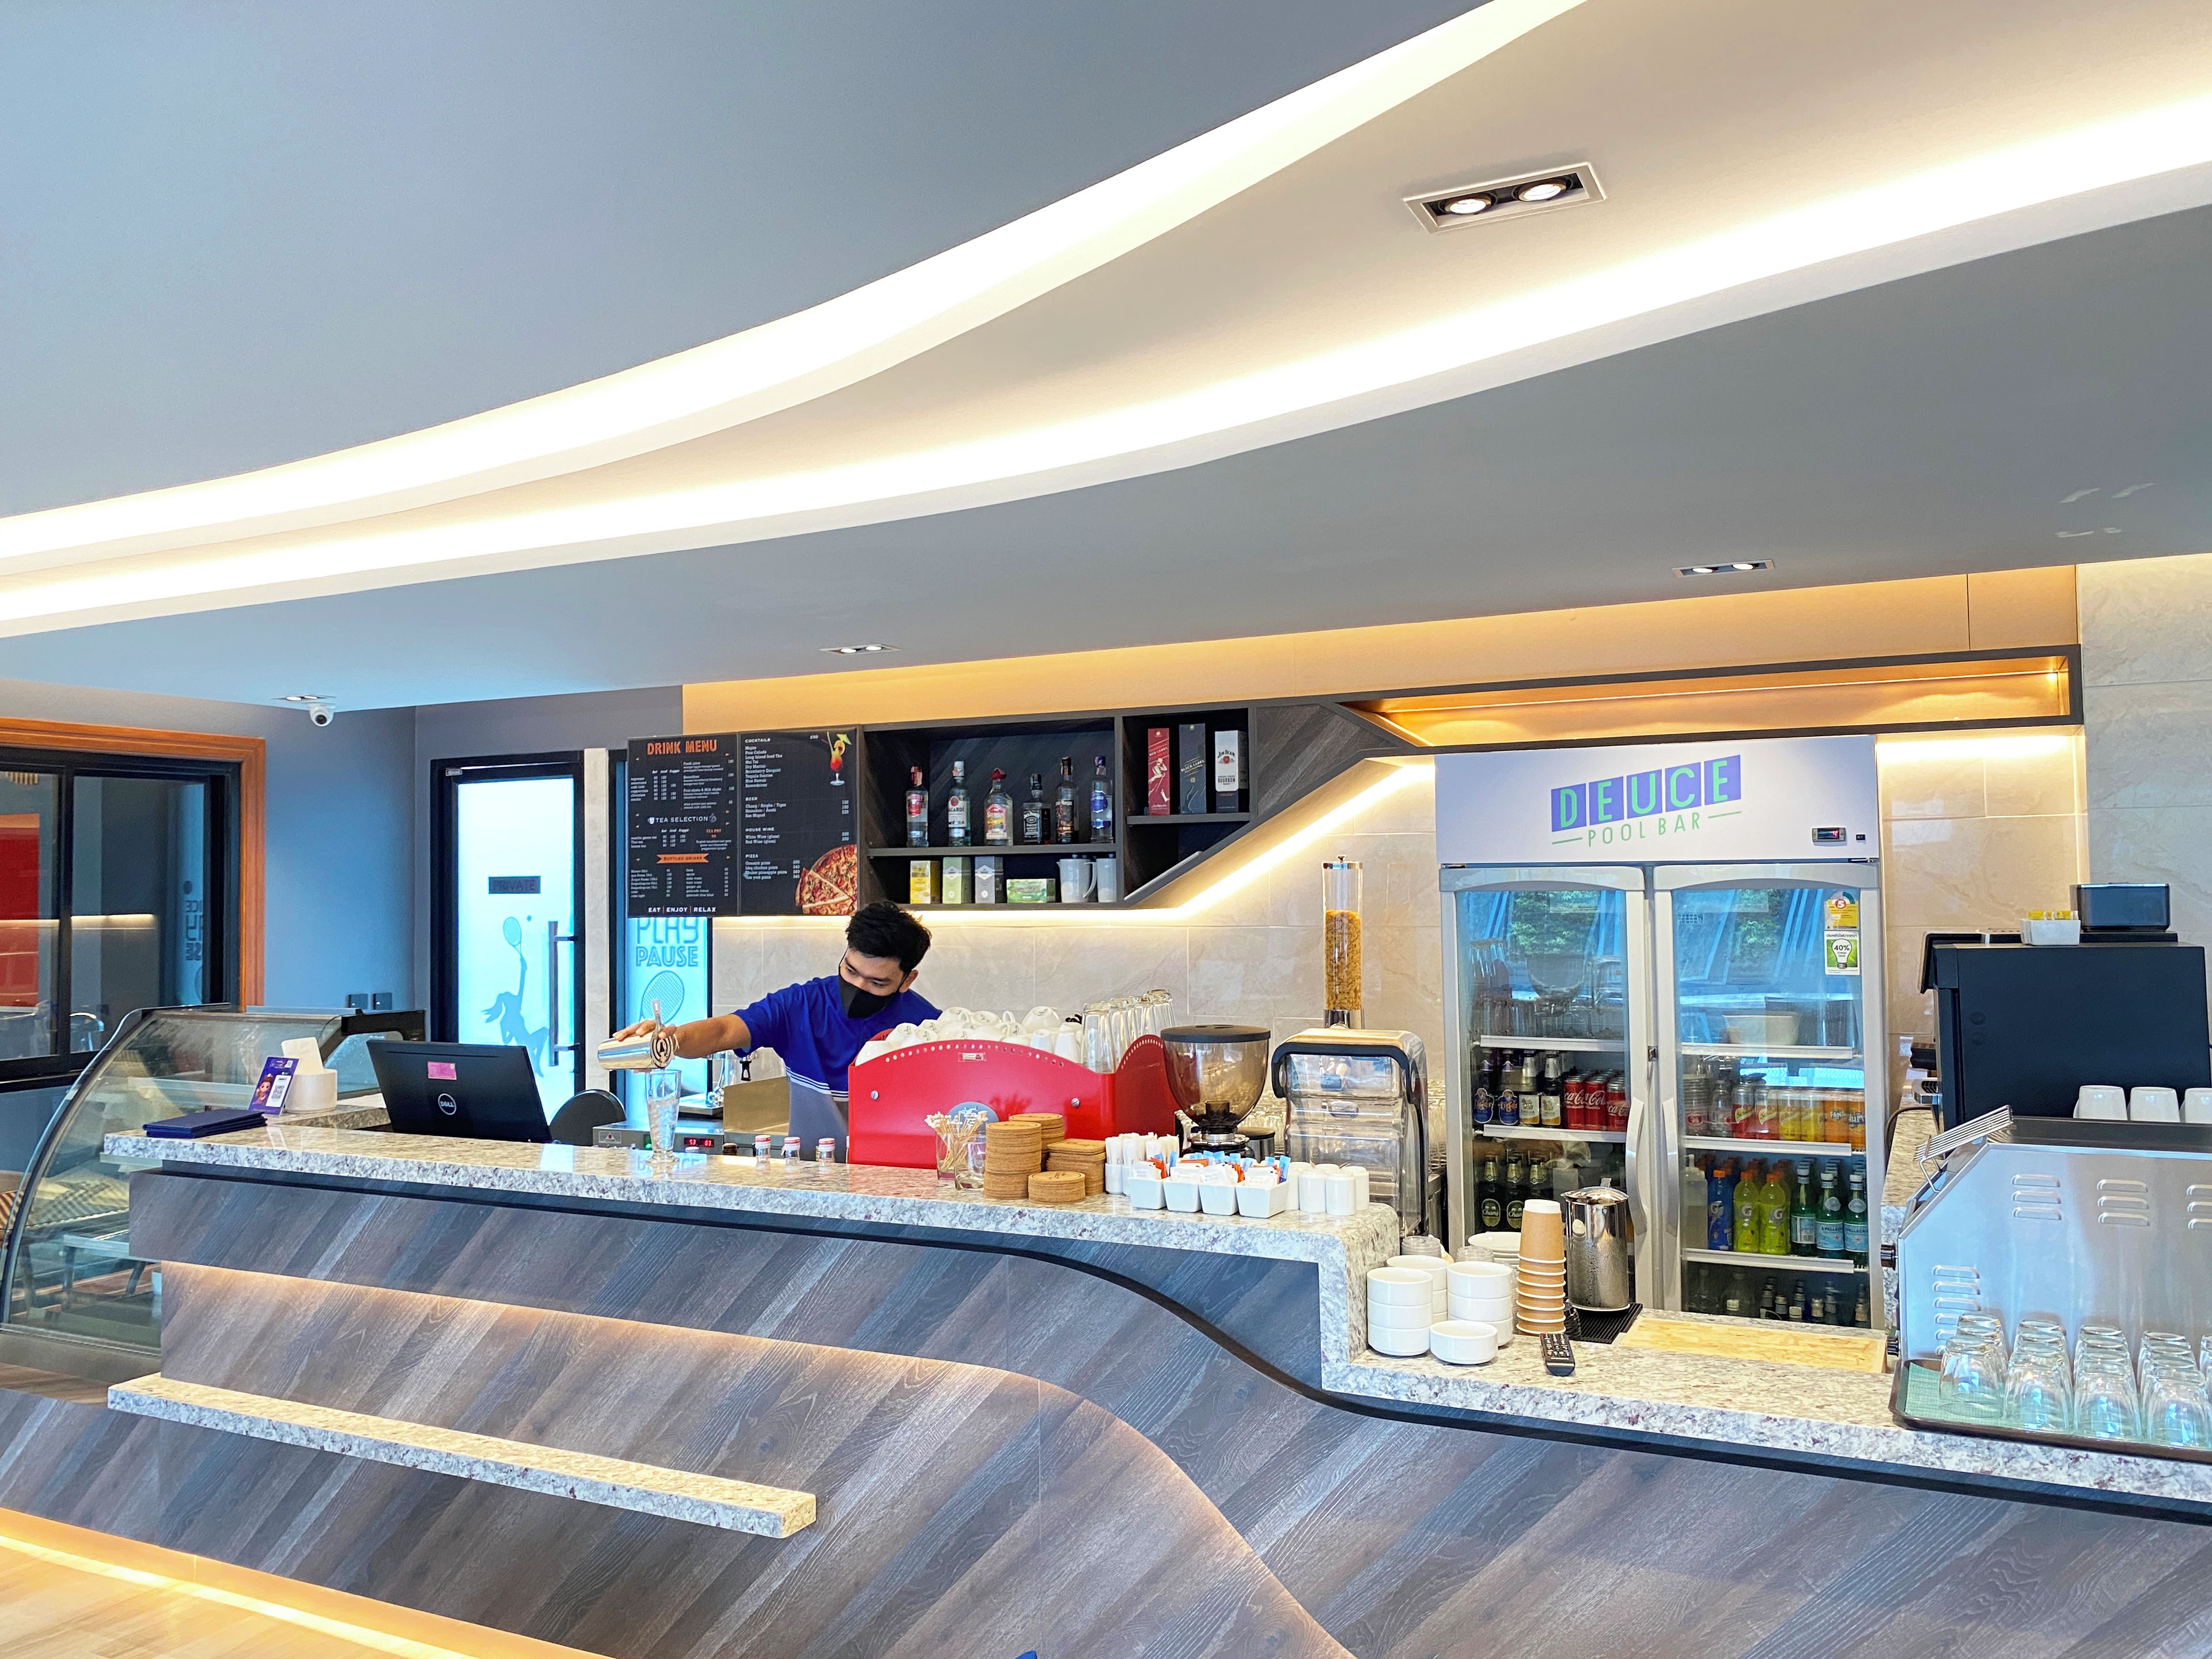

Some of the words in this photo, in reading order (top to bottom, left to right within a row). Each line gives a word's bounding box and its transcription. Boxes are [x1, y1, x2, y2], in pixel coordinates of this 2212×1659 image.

[647, 741, 681, 755] DRINK
[685, 739, 717, 753] MENU
[1559, 760, 1728, 828] DEUCE
[1588, 821, 1645, 847] POOL
[1658, 812, 1700, 836] BAR
[493, 880, 536, 891] PRIVATE
[635, 946, 698, 967] PAUSE
